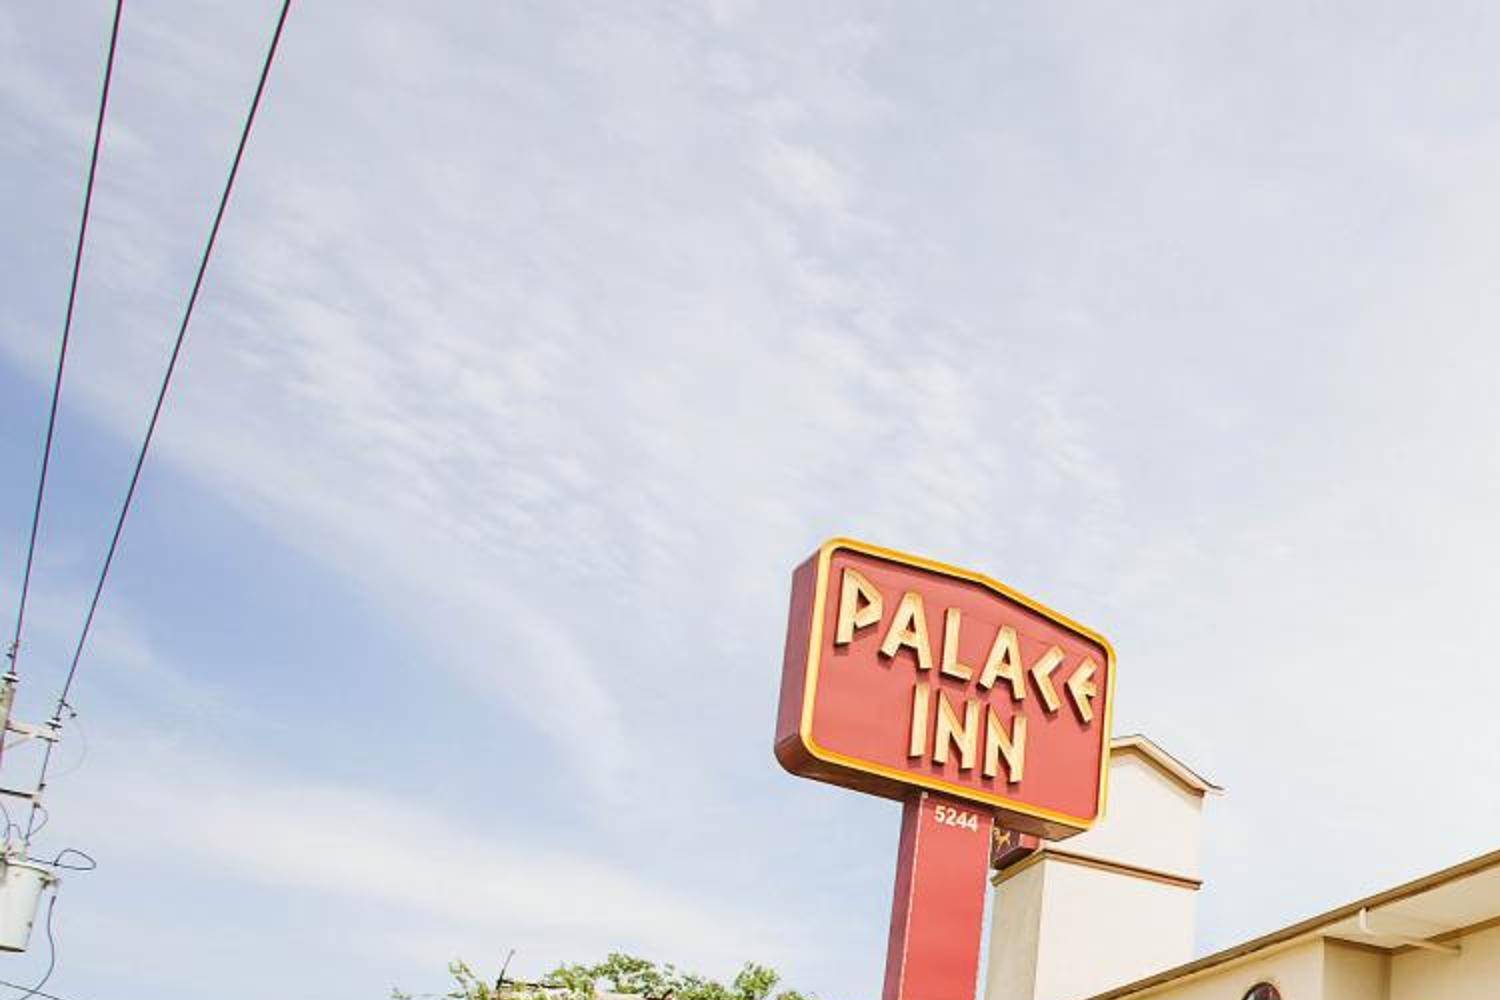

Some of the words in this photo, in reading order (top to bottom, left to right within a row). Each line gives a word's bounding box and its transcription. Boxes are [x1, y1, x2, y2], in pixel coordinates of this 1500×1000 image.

[836, 567, 1098, 723] PALACE
[907, 681, 1028, 783] INN
[934, 805, 979, 832] 5244
